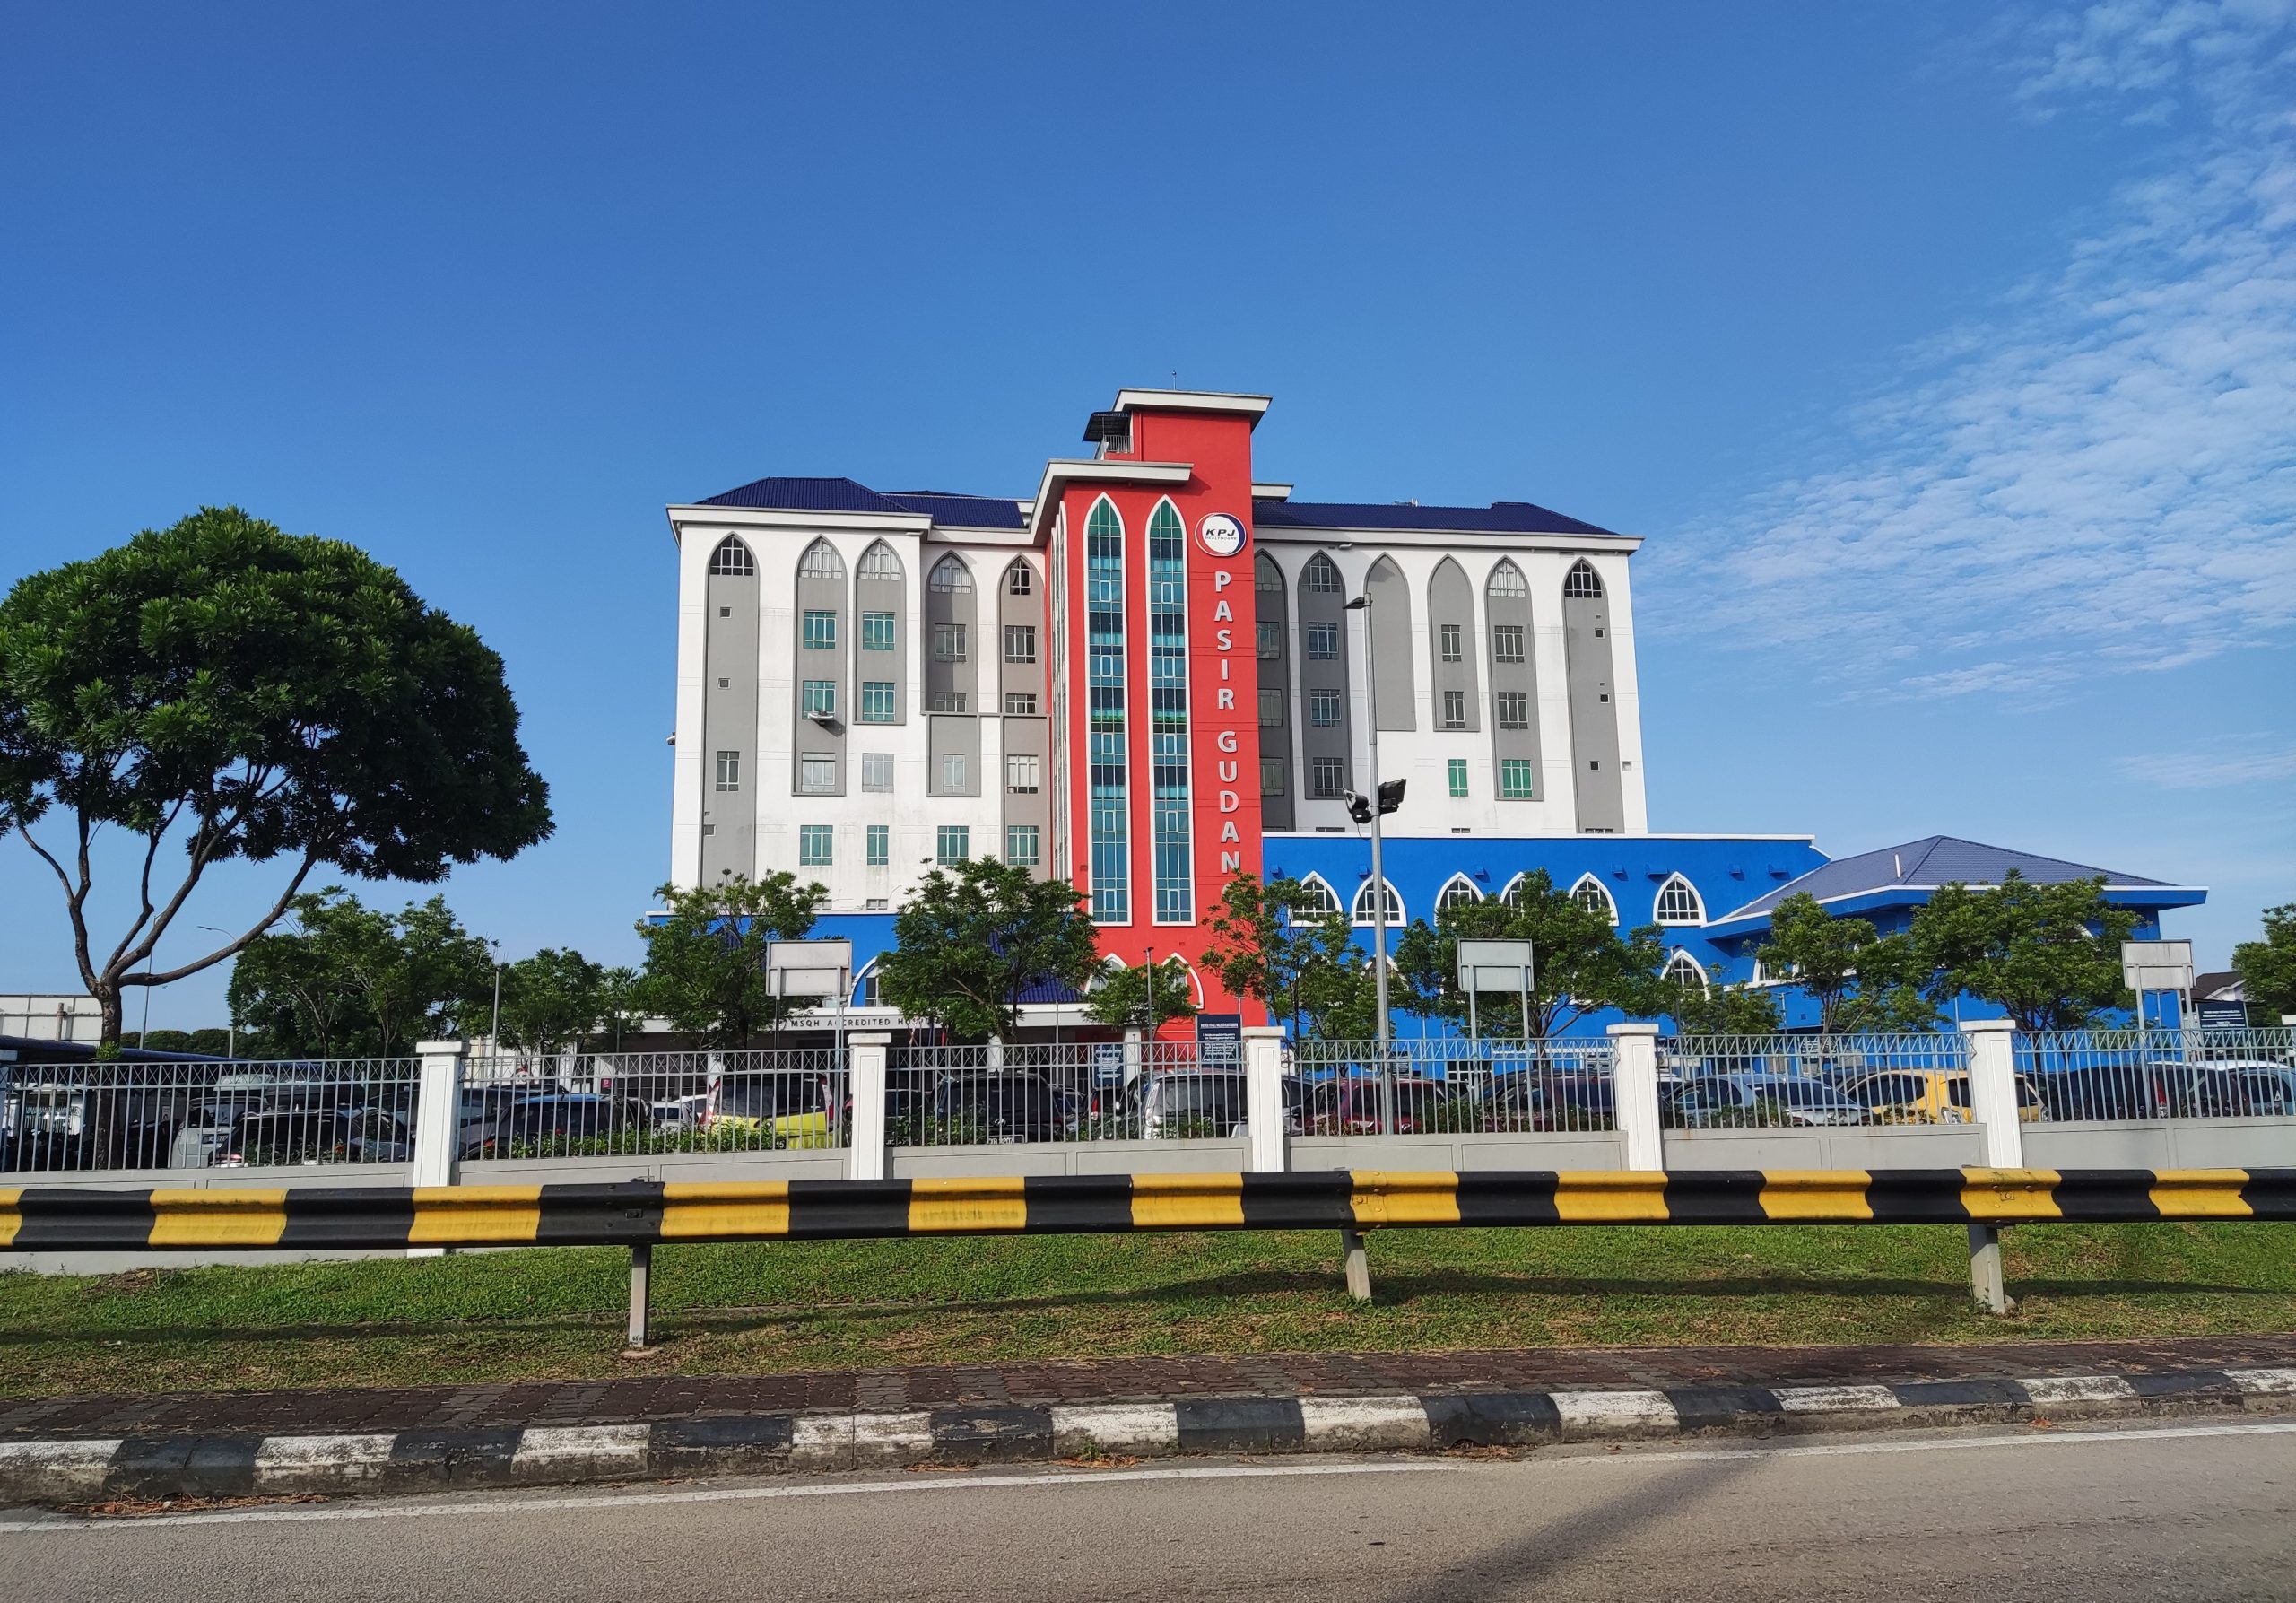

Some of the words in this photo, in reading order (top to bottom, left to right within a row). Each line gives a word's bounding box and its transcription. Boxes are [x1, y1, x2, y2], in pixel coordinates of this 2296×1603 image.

[1205, 528, 1236, 536] KPJ
[1213, 571, 1235, 710] PASIR
[1217, 730, 1241, 904] GUDAN
[790, 1018, 820, 1027] MSQH
[827, 1018, 891, 1027] ACREDITED
